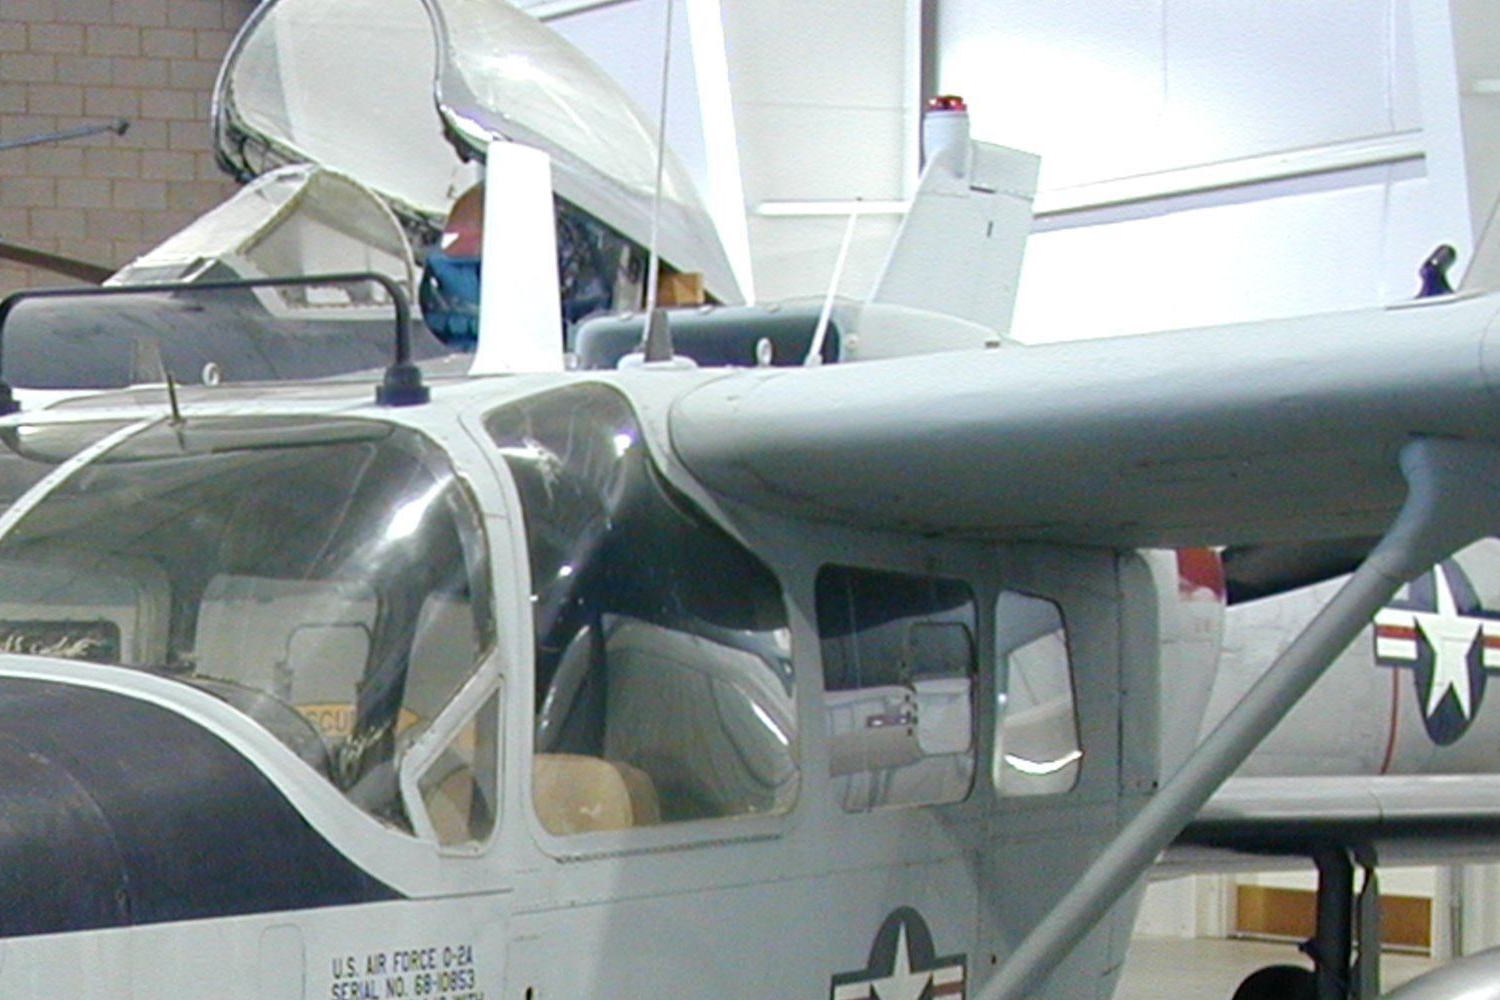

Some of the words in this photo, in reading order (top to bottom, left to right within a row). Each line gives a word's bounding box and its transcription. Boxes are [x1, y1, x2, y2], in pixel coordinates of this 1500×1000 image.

[332, 957, 359, 980] U.S.
[365, 953, 387, 975] AIR
[393, 948, 436, 973] FORCE
[386, 978, 407, 999] NO.
